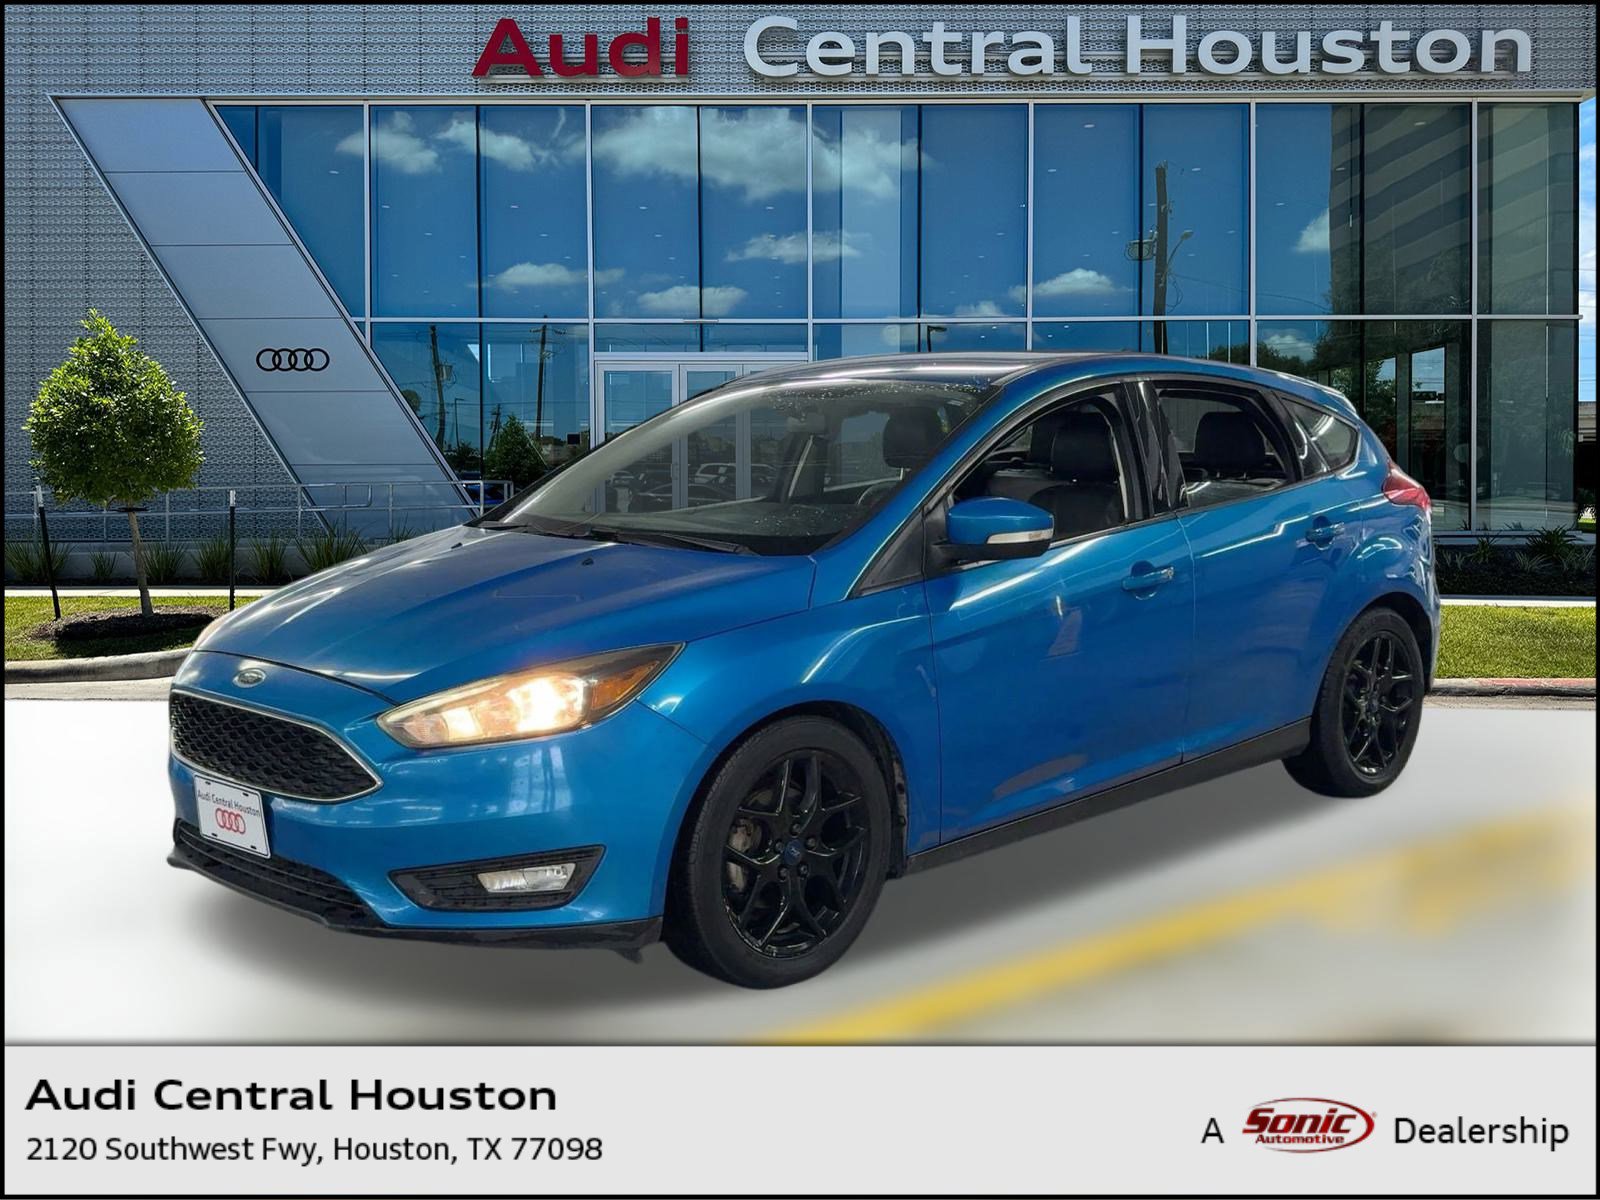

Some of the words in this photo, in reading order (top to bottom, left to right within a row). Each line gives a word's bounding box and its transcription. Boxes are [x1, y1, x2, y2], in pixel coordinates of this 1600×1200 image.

[473, 17, 689, 78] Audi
[743, 15, 1093, 77] Central
[1126, 15, 1531, 75] Houston
